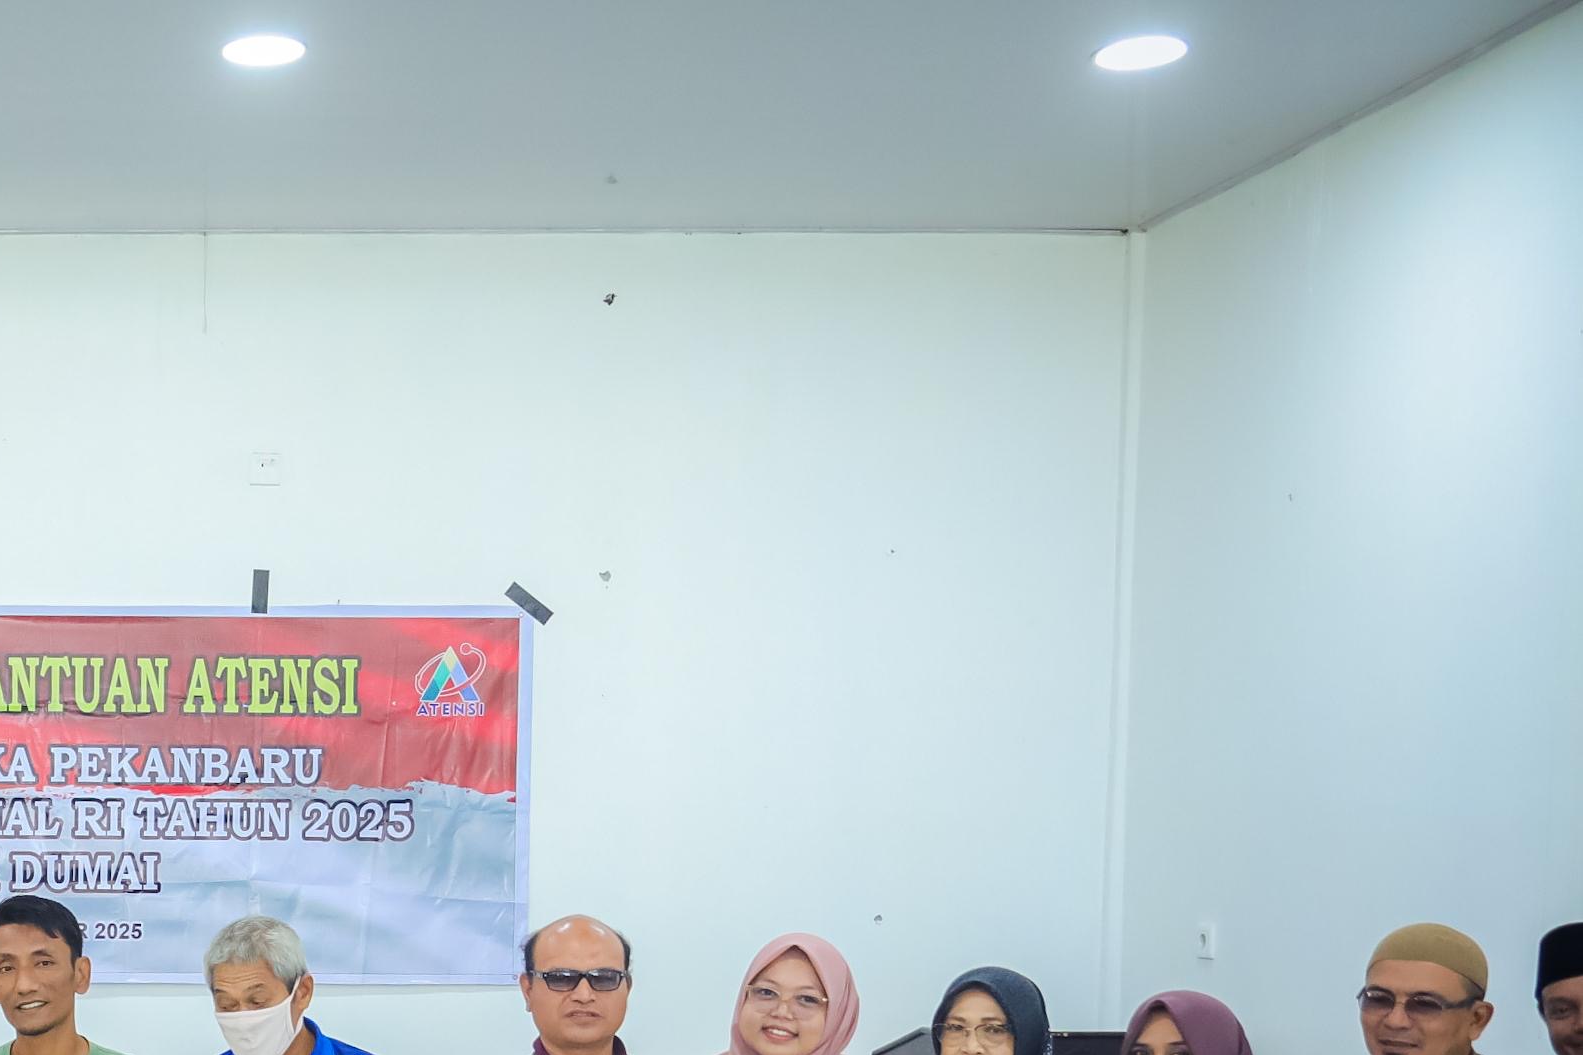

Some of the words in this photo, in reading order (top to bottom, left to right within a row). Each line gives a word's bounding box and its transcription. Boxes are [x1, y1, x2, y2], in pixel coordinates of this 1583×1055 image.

[181, 656, 360, 715] ATENSI
[416, 702, 485, 716] ATENSI
[48, 746, 324, 786] PEKANBARU
[71, 798, 125, 840] RI
[133, 799, 292, 840] TAHUN
[301, 799, 416, 841] 2025
[9, 852, 162, 894] DUMAI
[94, 922, 143, 940] 2025
